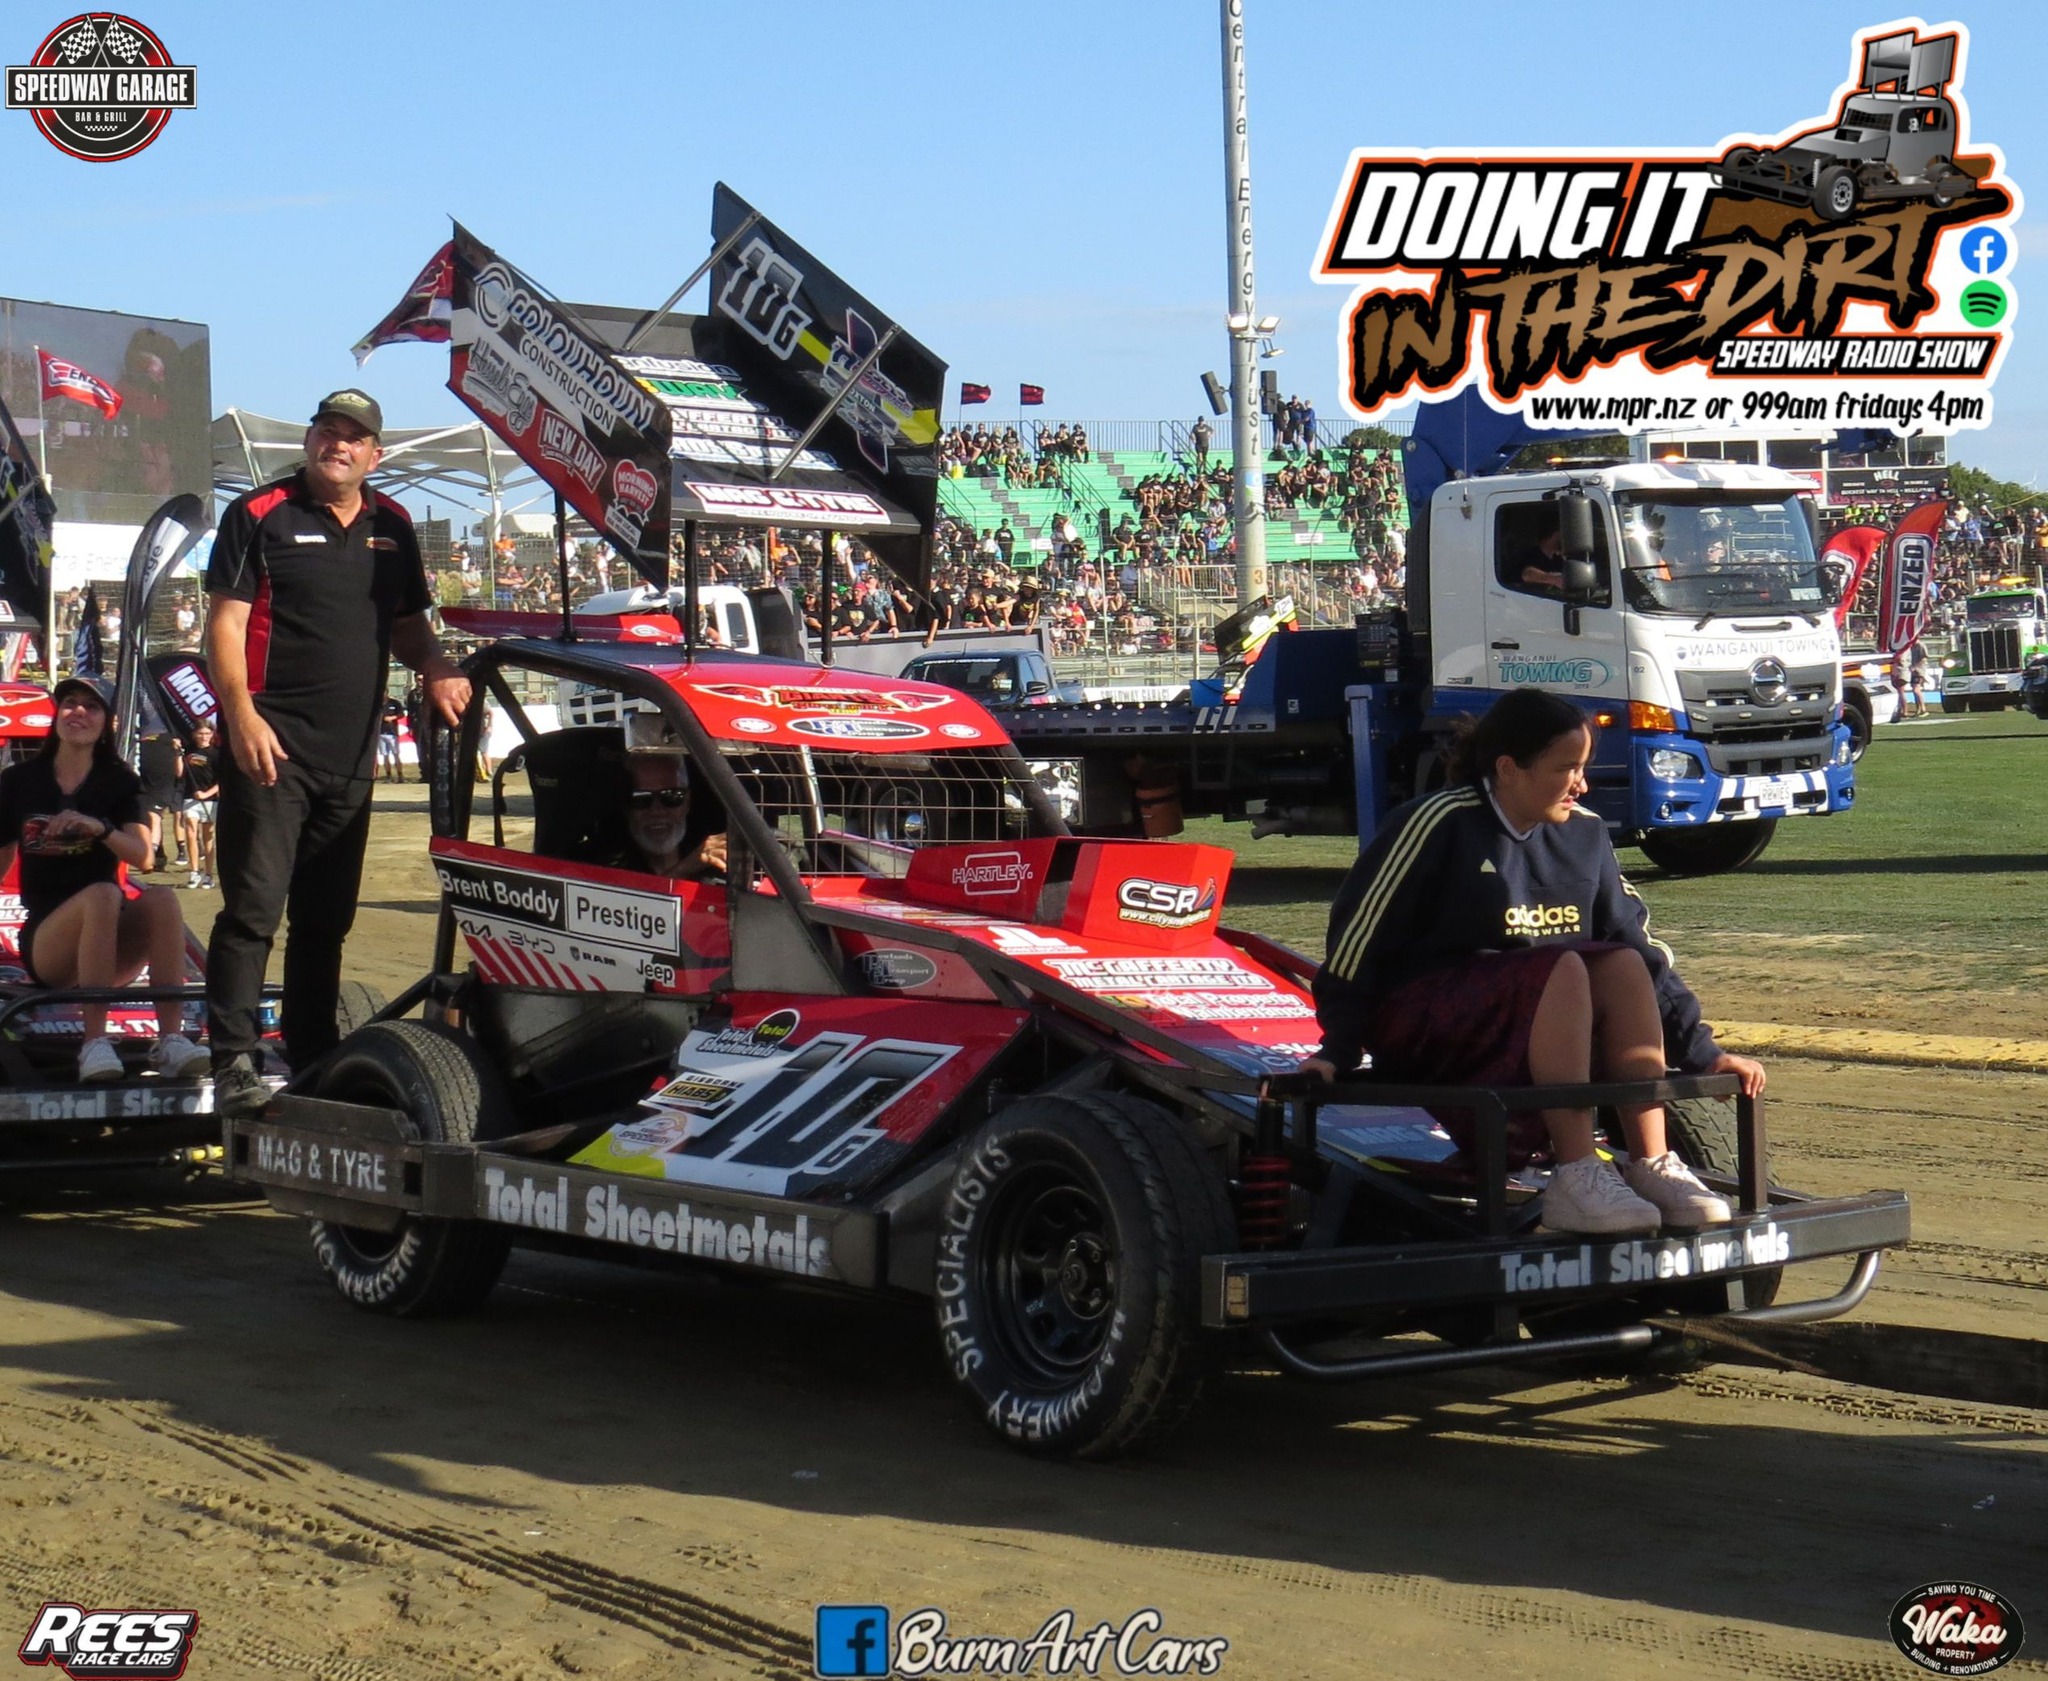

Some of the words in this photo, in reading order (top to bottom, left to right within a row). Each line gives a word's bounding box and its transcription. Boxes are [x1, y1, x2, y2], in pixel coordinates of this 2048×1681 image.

[521, 339, 616, 432] CONSTRUCTION
[543, 415, 578, 458] NEW
[573, 441, 602, 484] DAY
[1873, 470, 1900, 481] HELL
[696, 485, 771, 505] MAG
[1899, 544, 1924, 614] ENZED
[1690, 639, 1774, 656] WANGANUI
[1779, 638, 1827, 652] TOWING
[1499, 662, 1593, 683] TOWING
[167, 665, 216, 716] MAG
[439, 869, 491, 901] Brent
[494, 881, 559, 921] Boddy
[1120, 882, 1197, 914] CSR
[577, 896, 666, 938] Prestige
[1505, 904, 1580, 926] adidas
[582, 952, 616, 966] RAM
[637, 959, 673, 983] Jeep
[758, 1024, 791, 1036] Total
[697, 1039, 777, 1057] Sheetmetals
[667, 1085, 717, 1098] HIABS
[686, 1076, 744, 1088] GISBORNE
[25, 1090, 107, 1120] Total
[257, 1136, 302, 1173] MAG
[308, 1146, 322, 1178] &
[328, 1148, 387, 1192] TYRE
[485, 1167, 568, 1232] Total
[585, 1184, 830, 1276] Sheetmetals
[936, 1135, 1013, 1381] SPECIALISTS
[1500, 1245, 1592, 1292] Total
[1609, 1222, 1790, 1284] Sheetmetals
